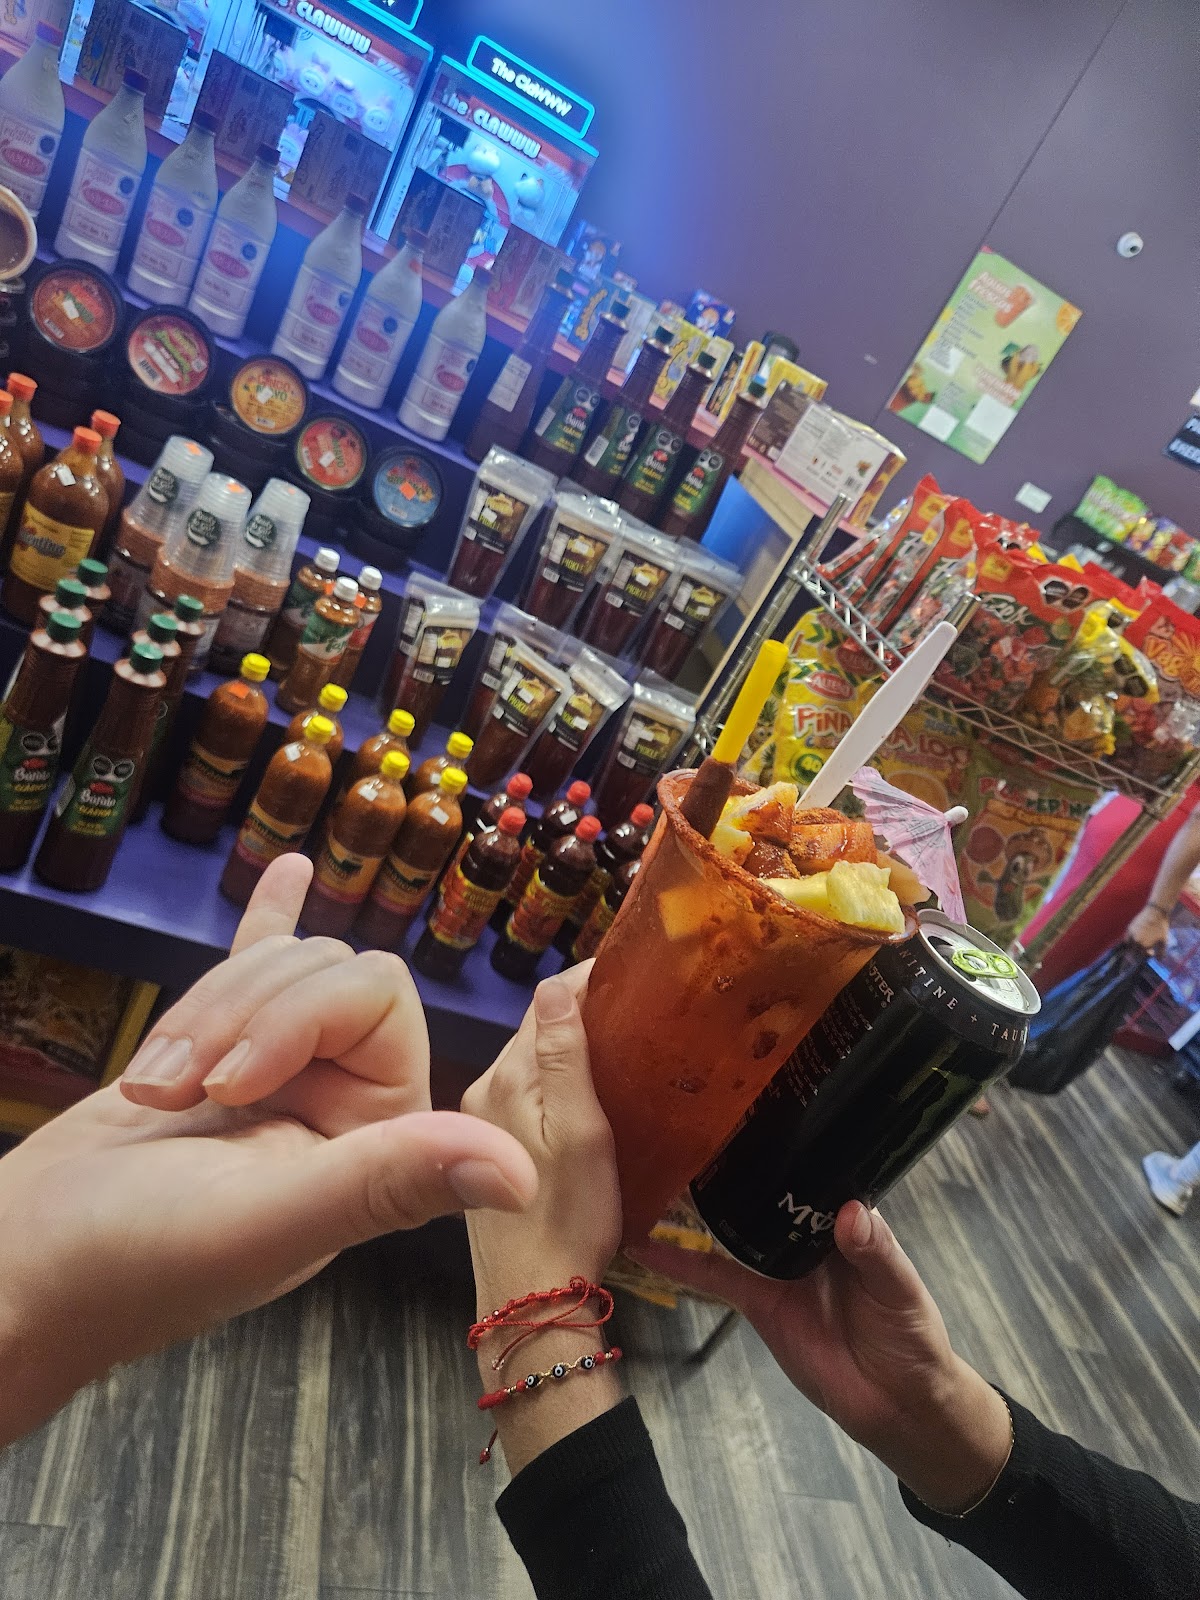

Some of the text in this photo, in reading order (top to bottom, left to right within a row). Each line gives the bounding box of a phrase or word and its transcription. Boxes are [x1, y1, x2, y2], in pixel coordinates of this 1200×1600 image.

[492, 57, 516, 83] The
[868, 960, 895, 1003] STER
[899, 951, 959, 1010] NITINE
